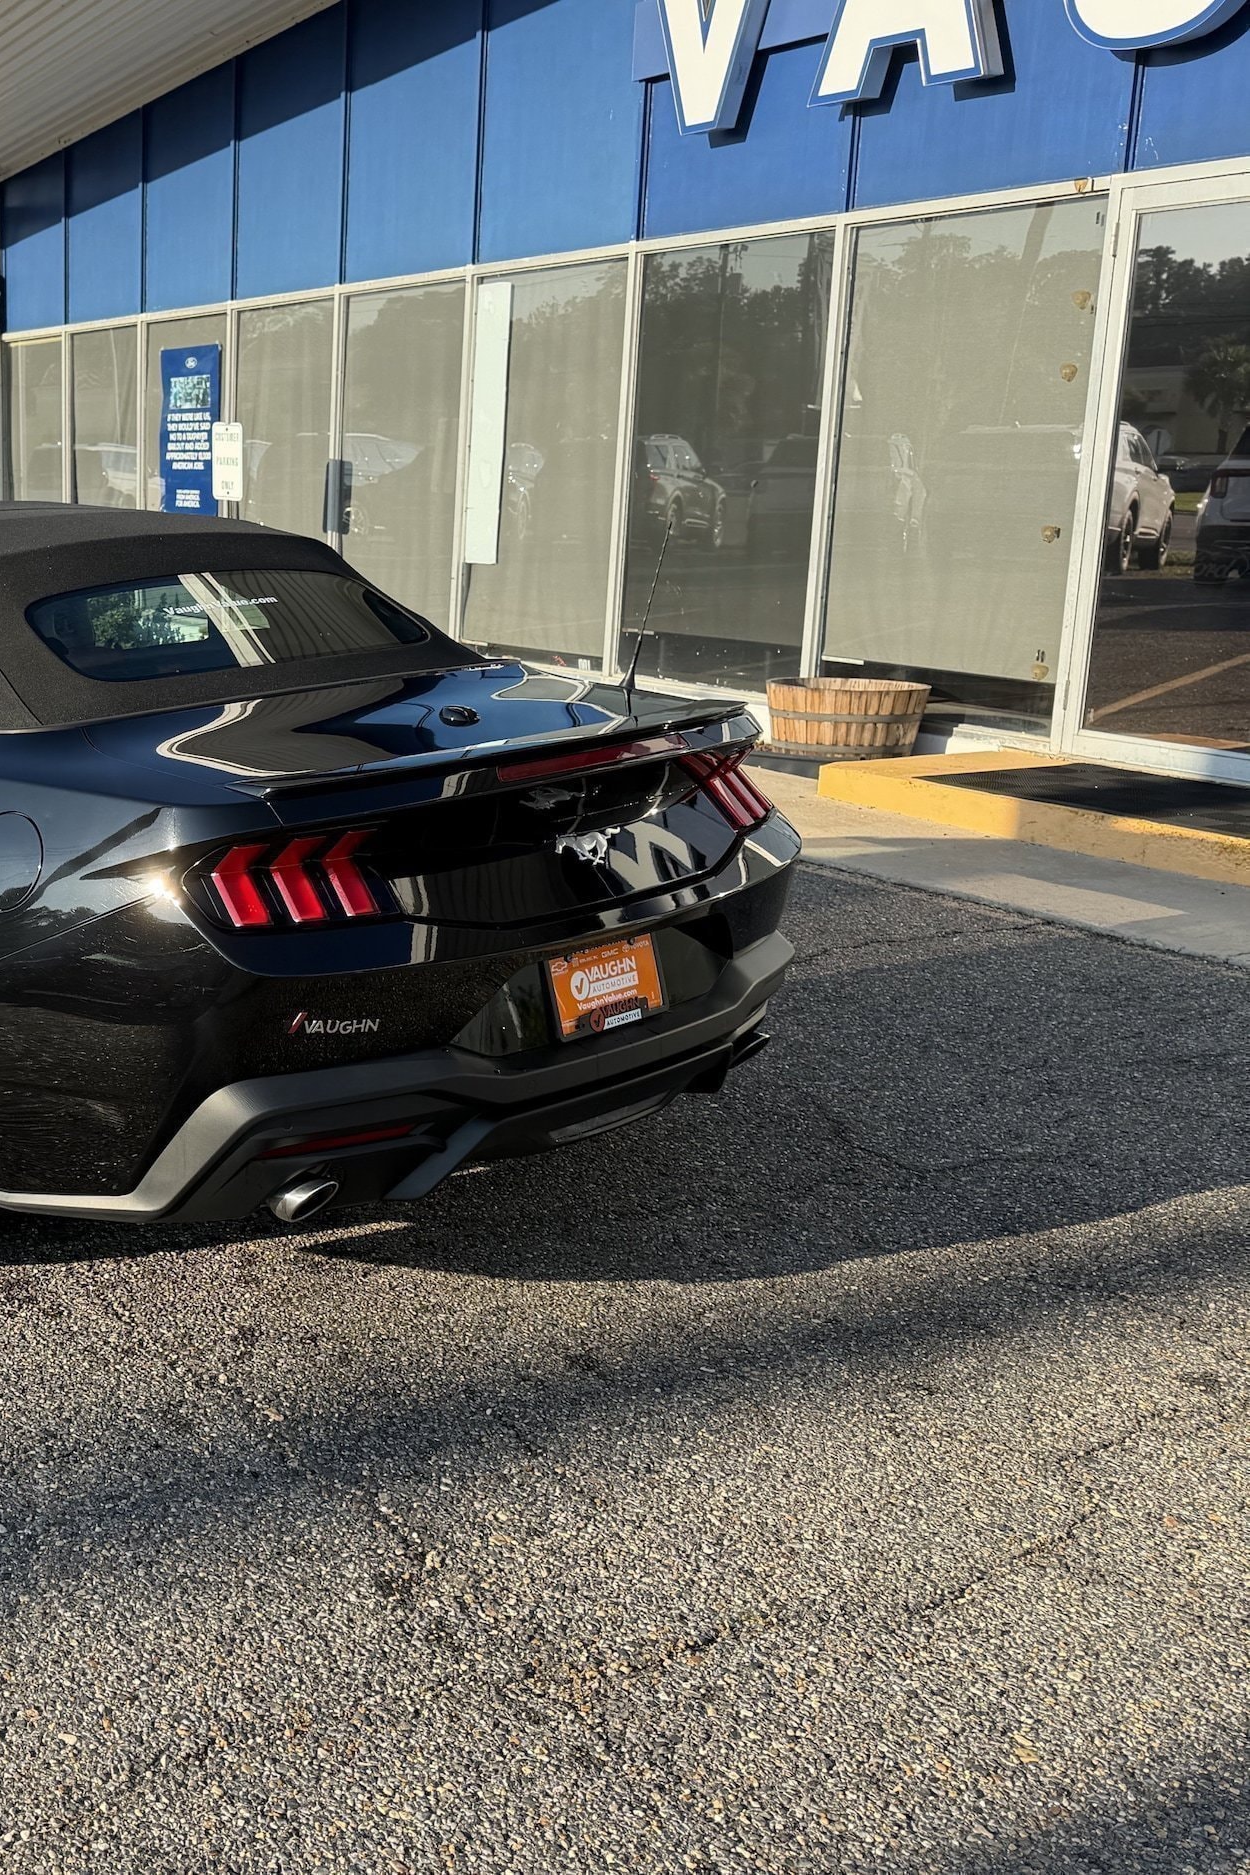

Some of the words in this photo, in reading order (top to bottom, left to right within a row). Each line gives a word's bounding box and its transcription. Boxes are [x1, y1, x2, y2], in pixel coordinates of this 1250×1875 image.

[216, 457, 239, 467] PARKING
[221, 480, 234, 490] ONLY
[162, 595, 279, 616] VaughnVaue.com
[601, 948, 619, 959] GMC
[585, 955, 637, 982] VAUGHN
[592, 974, 637, 994] AUTOMOTIVE
[577, 989, 638, 1011] VaughnValue.com
[600, 997, 640, 1017] VAUGHN
[304, 1018, 380, 1035] VAUGHN
[607, 1012, 641, 1026] AUTOMOTIVE
